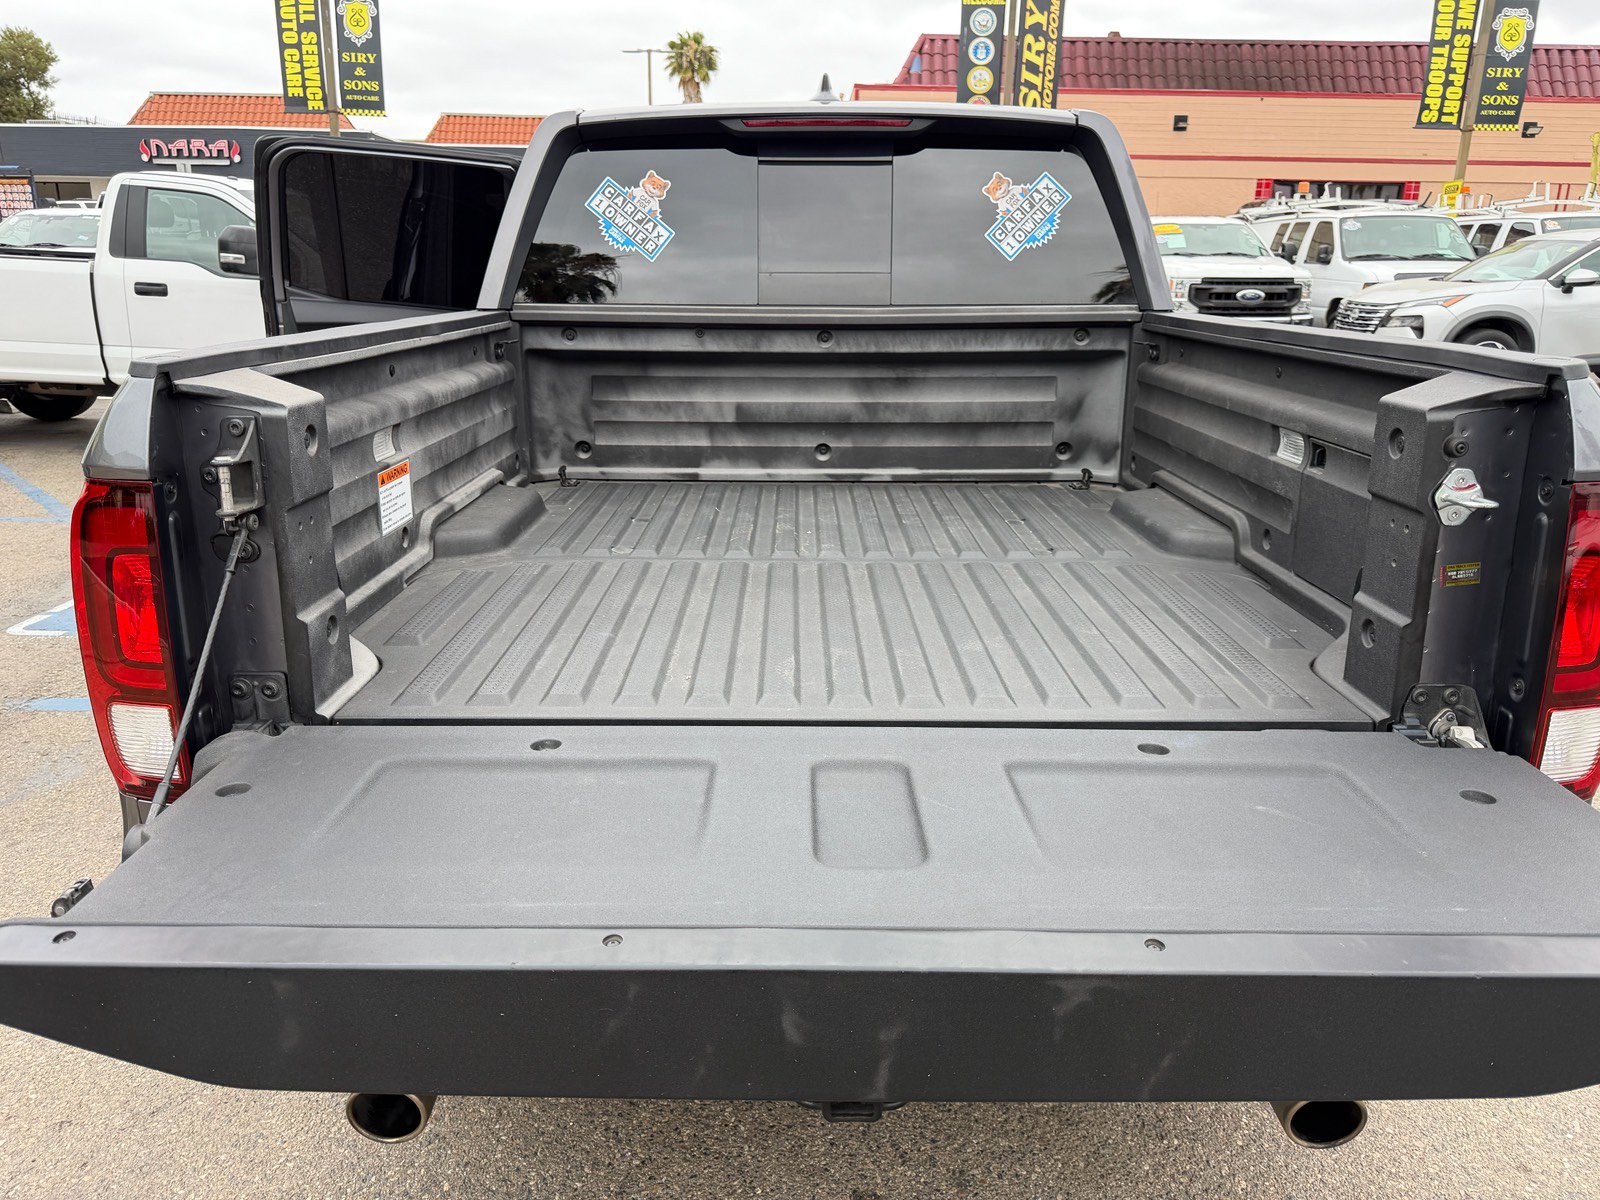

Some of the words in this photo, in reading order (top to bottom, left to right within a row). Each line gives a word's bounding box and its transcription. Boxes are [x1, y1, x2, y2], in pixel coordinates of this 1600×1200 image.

[1434, 0, 1456, 41] OUR
[1455, 0, 1477, 30] WE
[341, 52, 377, 64] SIRY
[1018, 0, 1048, 108] SIRY
[284, 48, 303, 97] CARE
[301, 31, 325, 111] SERVICE
[354, 66, 367, 76] &
[1440, 34, 1472, 125] SUPPORT
[1486, 67, 1525, 78] SIRY
[343, 79, 380, 92] SONS
[1420, 44, 1450, 123] TROOPS
[1496, 81, 1509, 91] &
[1480, 94, 1520, 106] SONS
[150, 138, 230, 157] NARA
[636, 200, 647, 210] FOX
[639, 194, 652, 206] CAR
[1005, 193, 1018, 205] CAR
[1010, 198, 1021, 209] FOX
[604, 186, 665, 241] CARFAX
[994, 183, 1053, 241] CARFAX
[1005, 241, 1016, 251] 1
[1013, 190, 1063, 242] OWNER
[594, 198, 603, 209] 1
[604, 208, 657, 253] OWNER
[386, 463, 408, 481] WARNING
